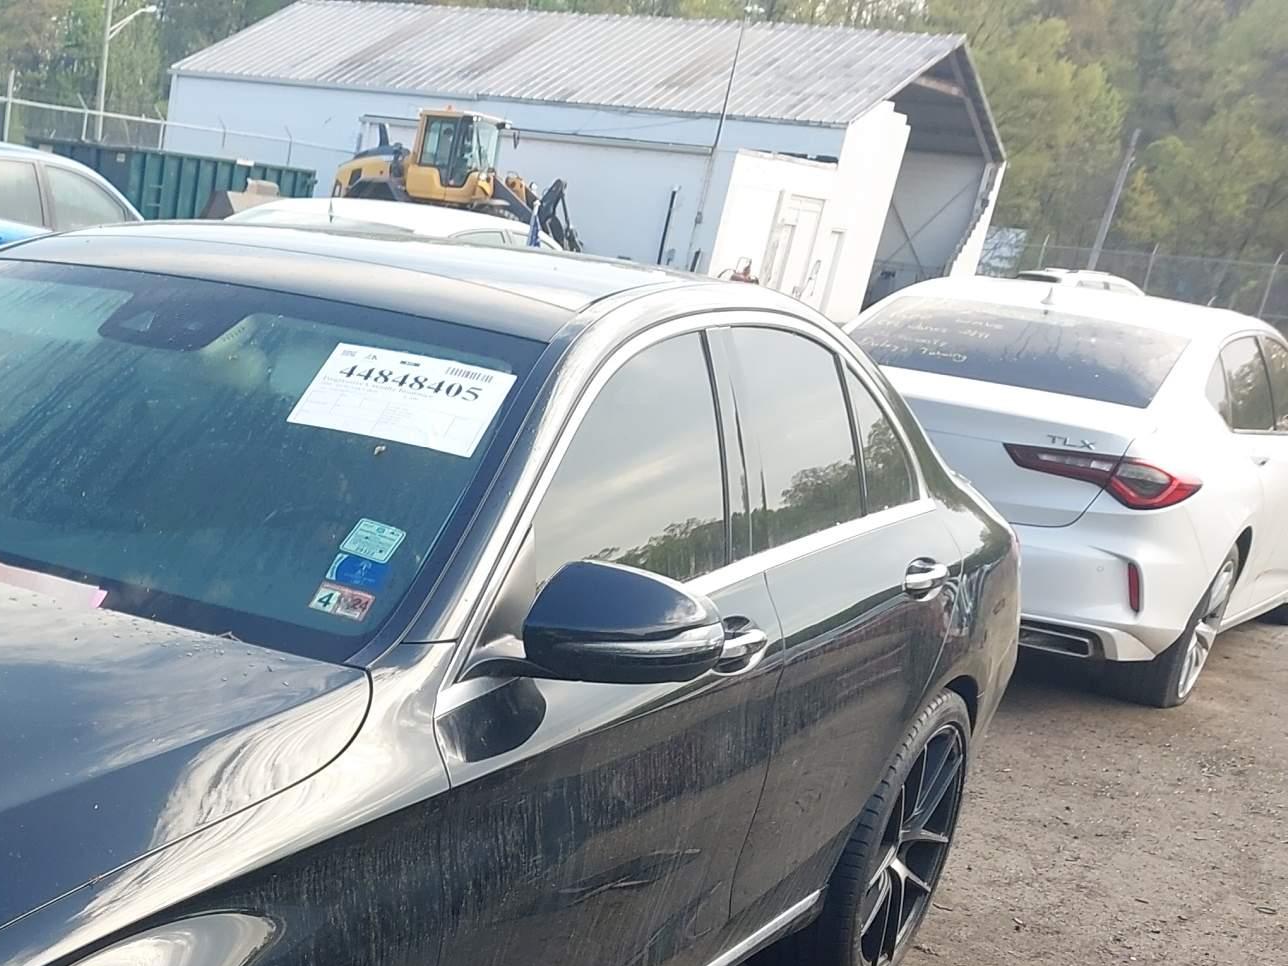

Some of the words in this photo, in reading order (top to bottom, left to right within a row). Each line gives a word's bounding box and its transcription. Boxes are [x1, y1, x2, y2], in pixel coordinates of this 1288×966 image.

[339, 364, 483, 402] 44848405
[1046, 433, 1096, 451] TLX
[318, 592, 335, 608] 4
[352, 598, 369, 611] 24
